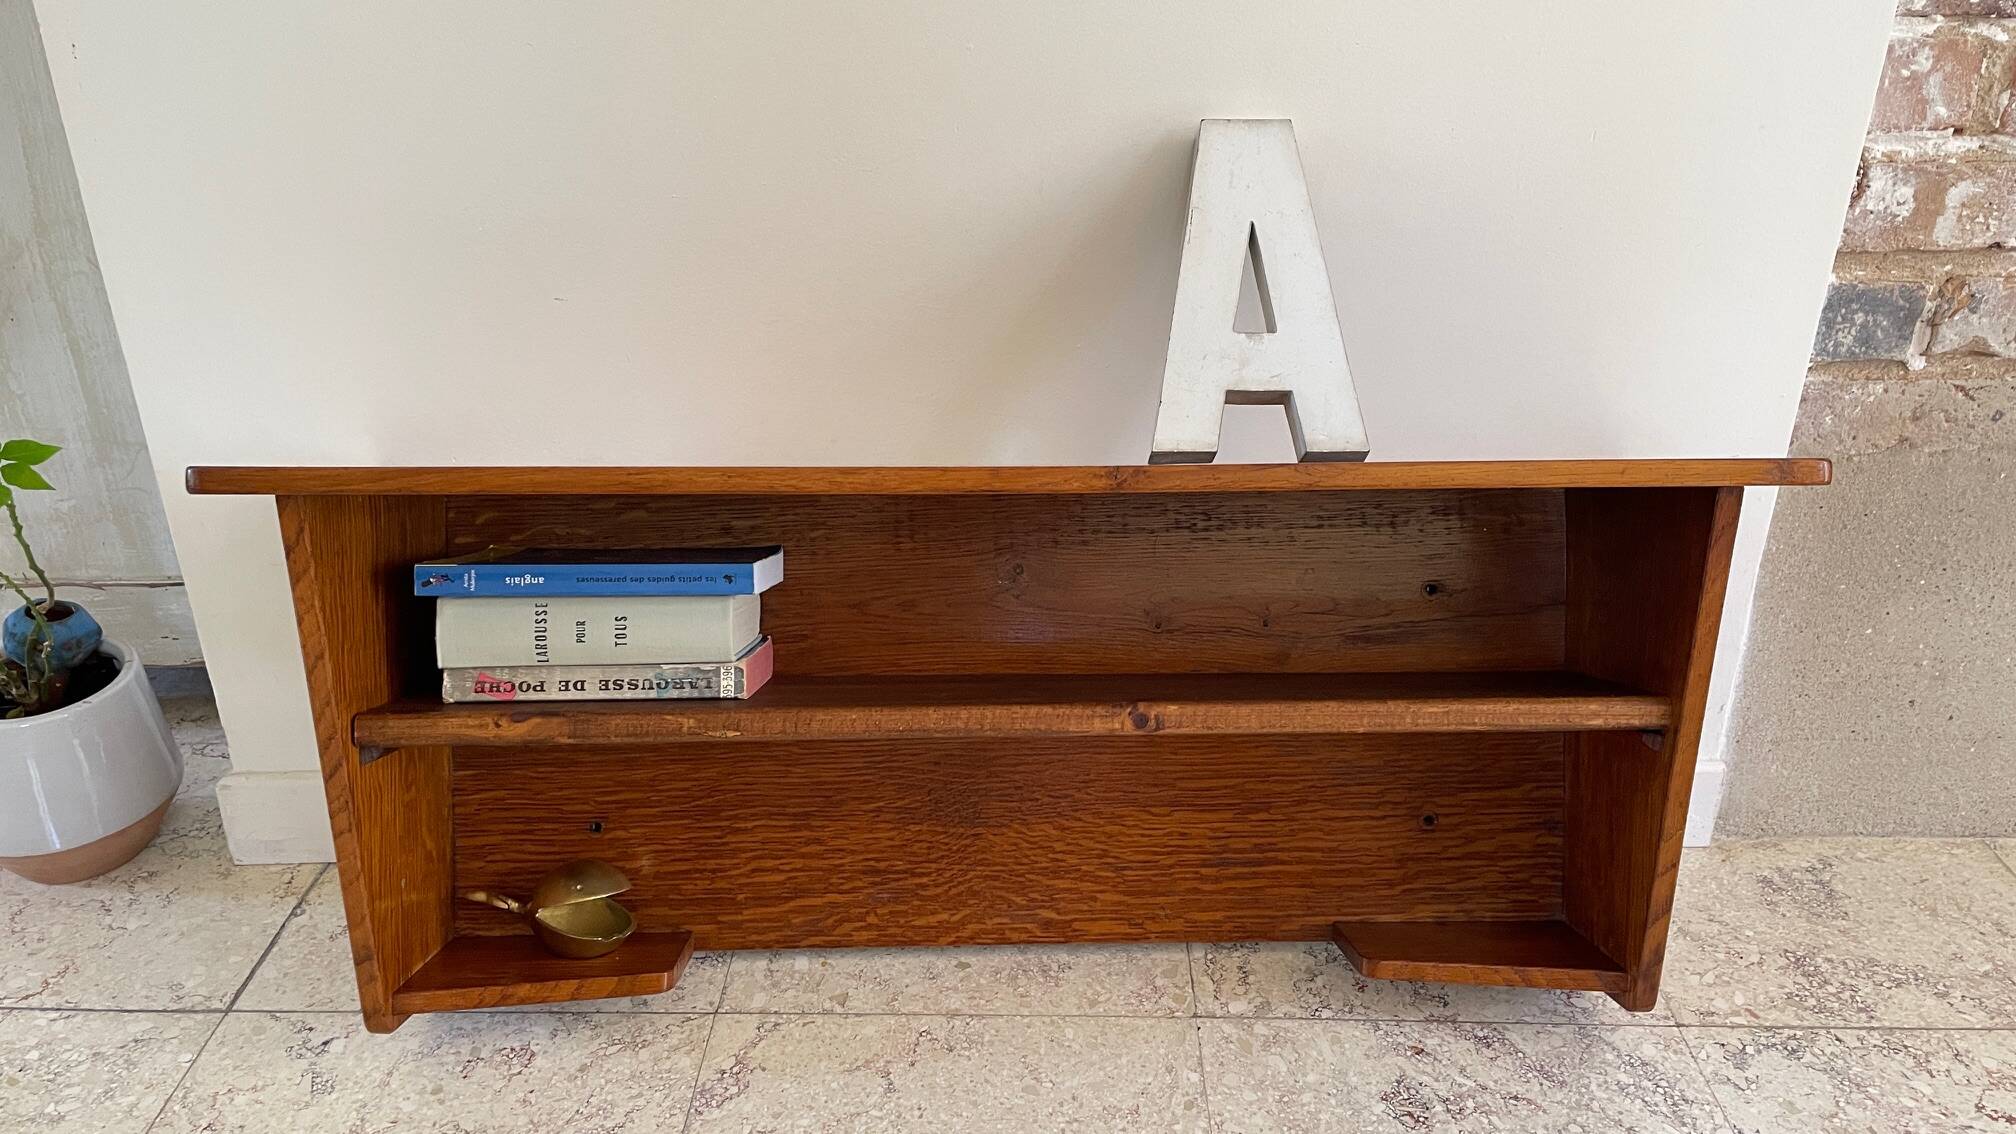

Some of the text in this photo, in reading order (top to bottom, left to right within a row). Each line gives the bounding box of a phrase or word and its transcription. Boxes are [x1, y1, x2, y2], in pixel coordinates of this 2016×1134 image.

[1149, 119, 1370, 463] A
[504, 574, 545, 587] anglais
[576, 575, 717, 585] les petits guides des paresseuses
[534, 602, 550, 663] LAROUSSE
[575, 620, 586, 643] POUR
[614, 615, 628, 647] TOUS
[474, 677, 714, 694] LAROUSSE DE POCHE
